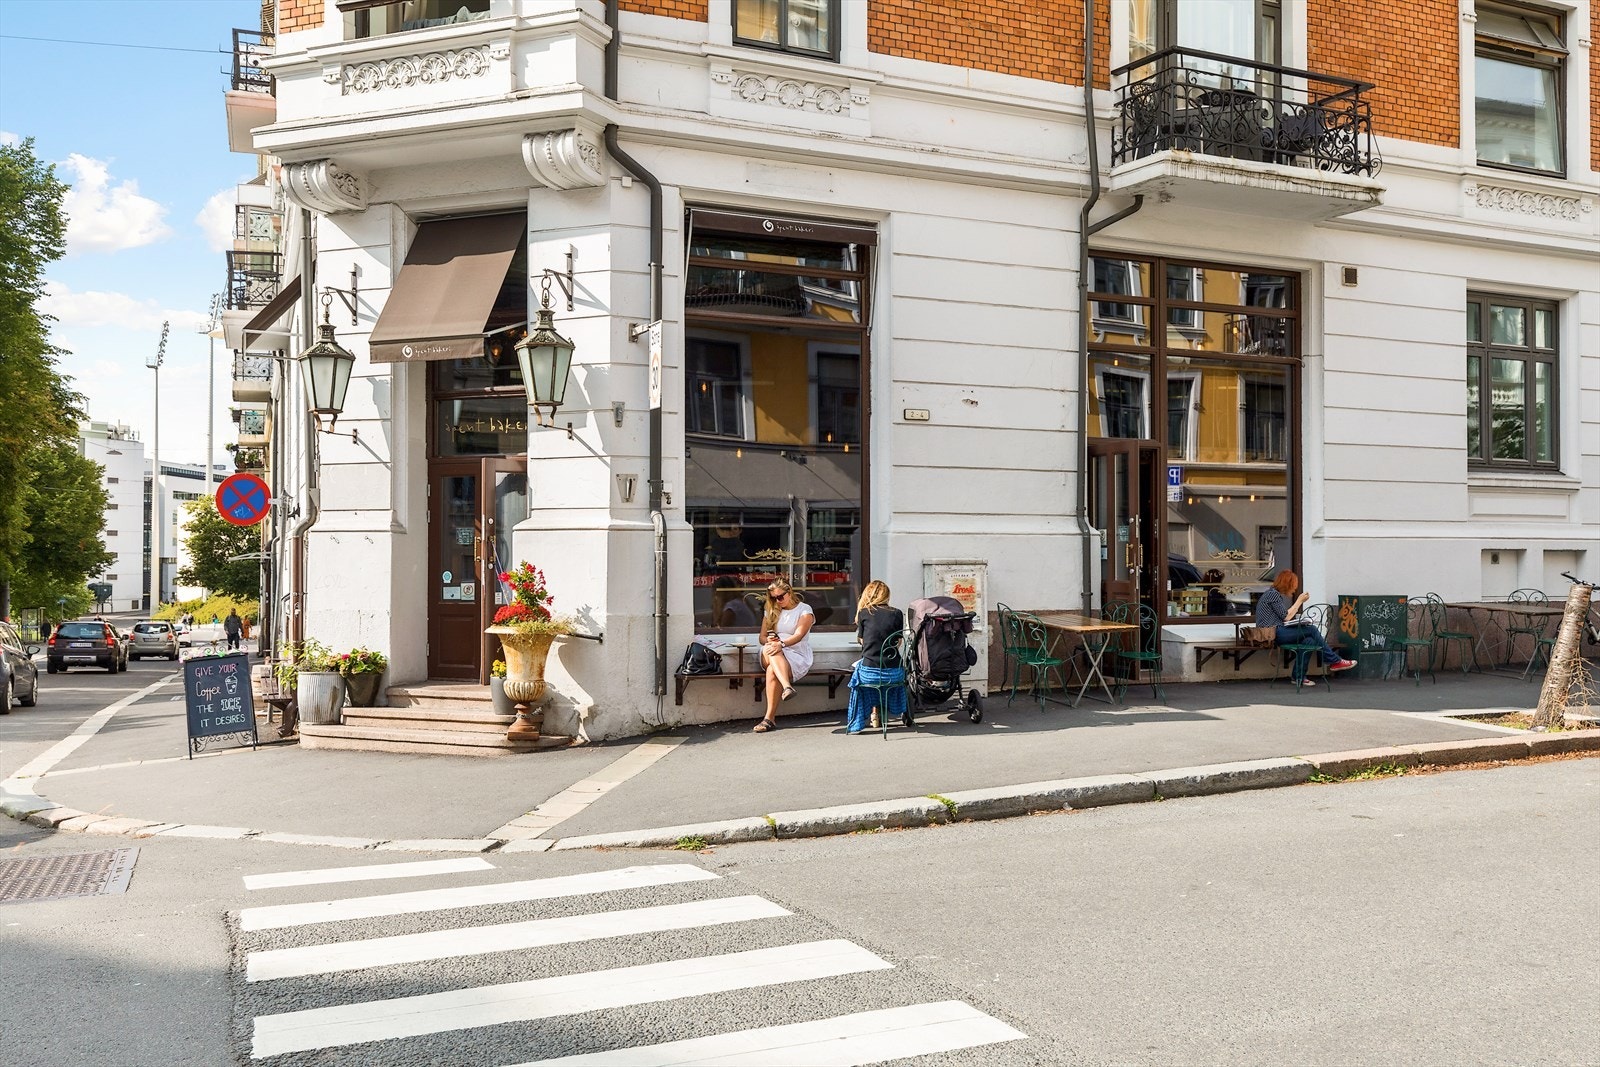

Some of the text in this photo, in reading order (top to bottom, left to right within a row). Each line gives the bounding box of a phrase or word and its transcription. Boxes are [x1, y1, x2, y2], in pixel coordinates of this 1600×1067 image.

[195, 664, 238, 678] GIVE YOUR
[196, 681, 221, 701] Coffee
[196, 697, 241, 713] THE ICE
[200, 714, 245, 728] IT DESIRES
